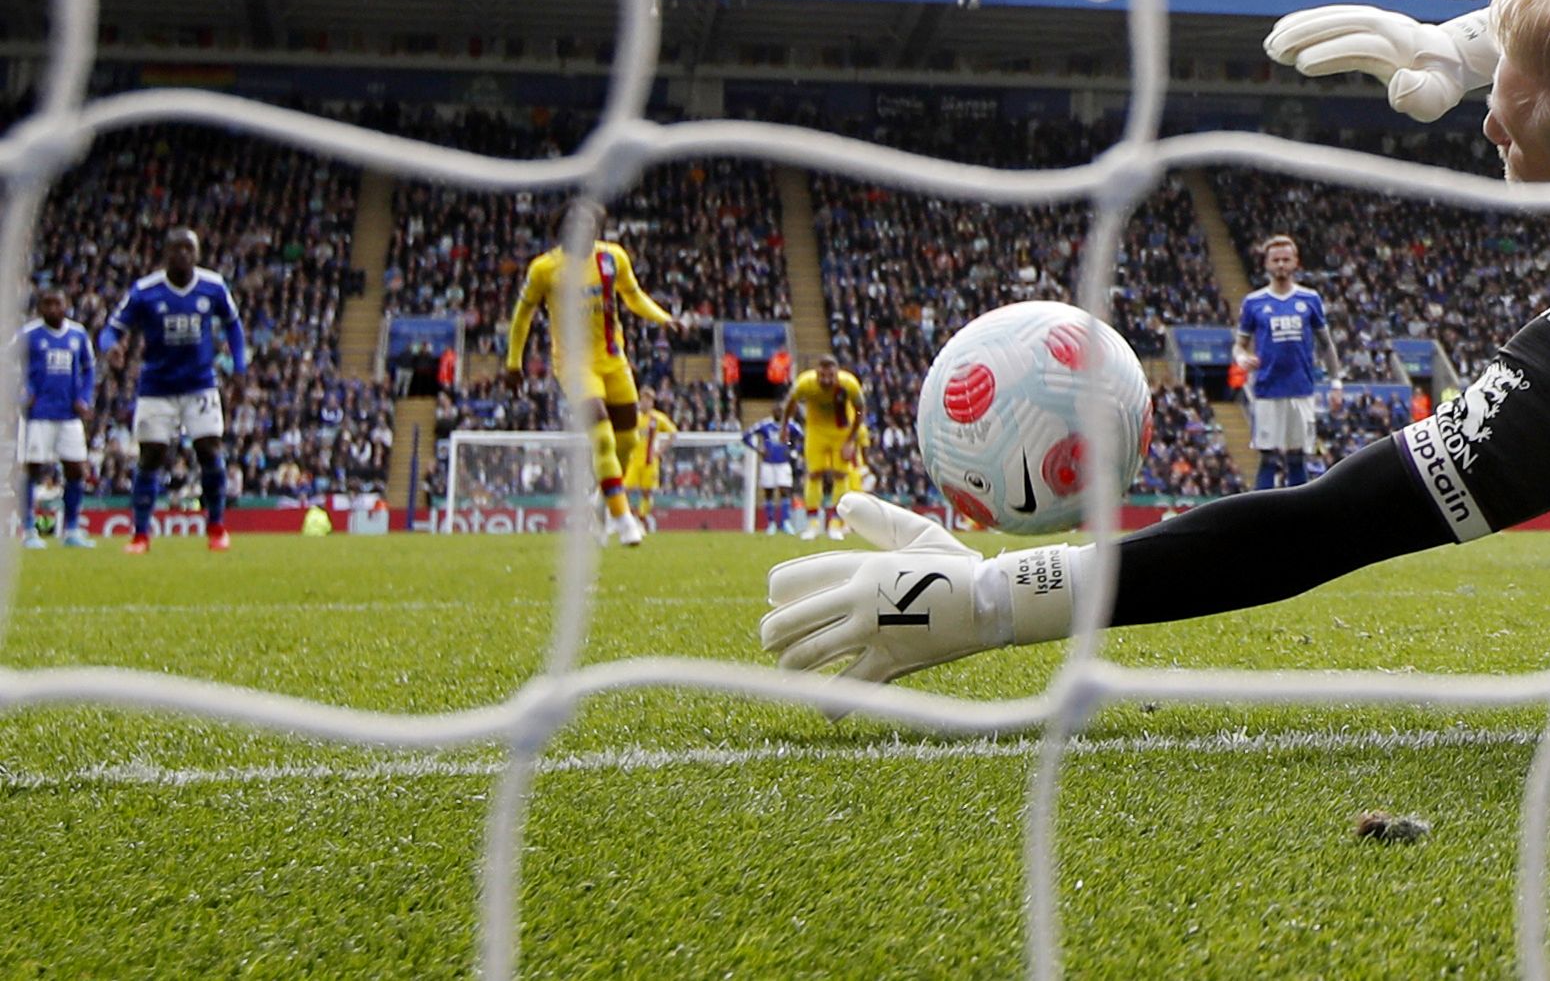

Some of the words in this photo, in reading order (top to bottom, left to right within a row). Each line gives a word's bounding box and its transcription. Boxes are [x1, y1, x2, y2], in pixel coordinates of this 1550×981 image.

[1413, 420, 1470, 522] aptain
[1016, 557, 1031, 585] Max
[1048, 549, 1063, 590] Nanna
